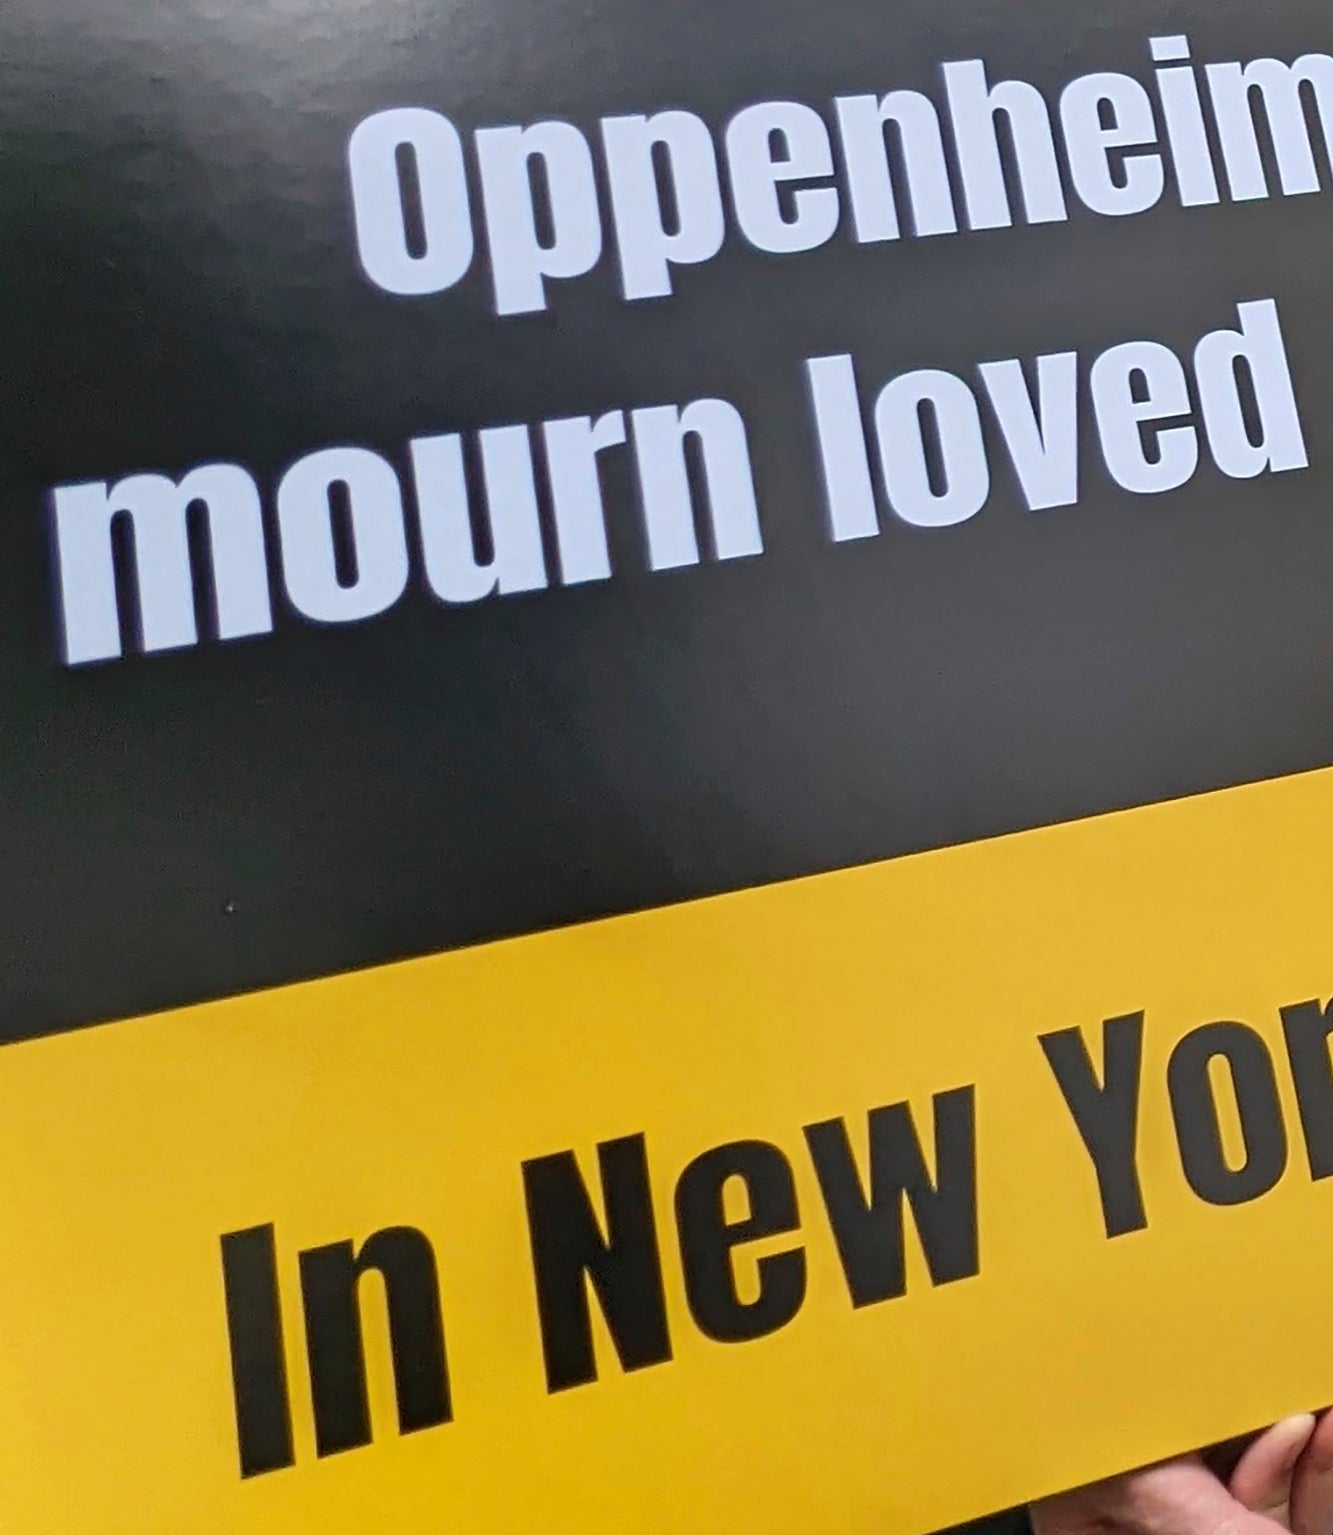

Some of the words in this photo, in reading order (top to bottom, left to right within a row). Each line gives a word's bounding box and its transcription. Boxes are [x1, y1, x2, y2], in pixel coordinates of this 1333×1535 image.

[54, 398, 764, 665] mourn
[806, 297, 1310, 543] loved
[218, 1221, 455, 1481] In
[519, 1082, 981, 1396] New
